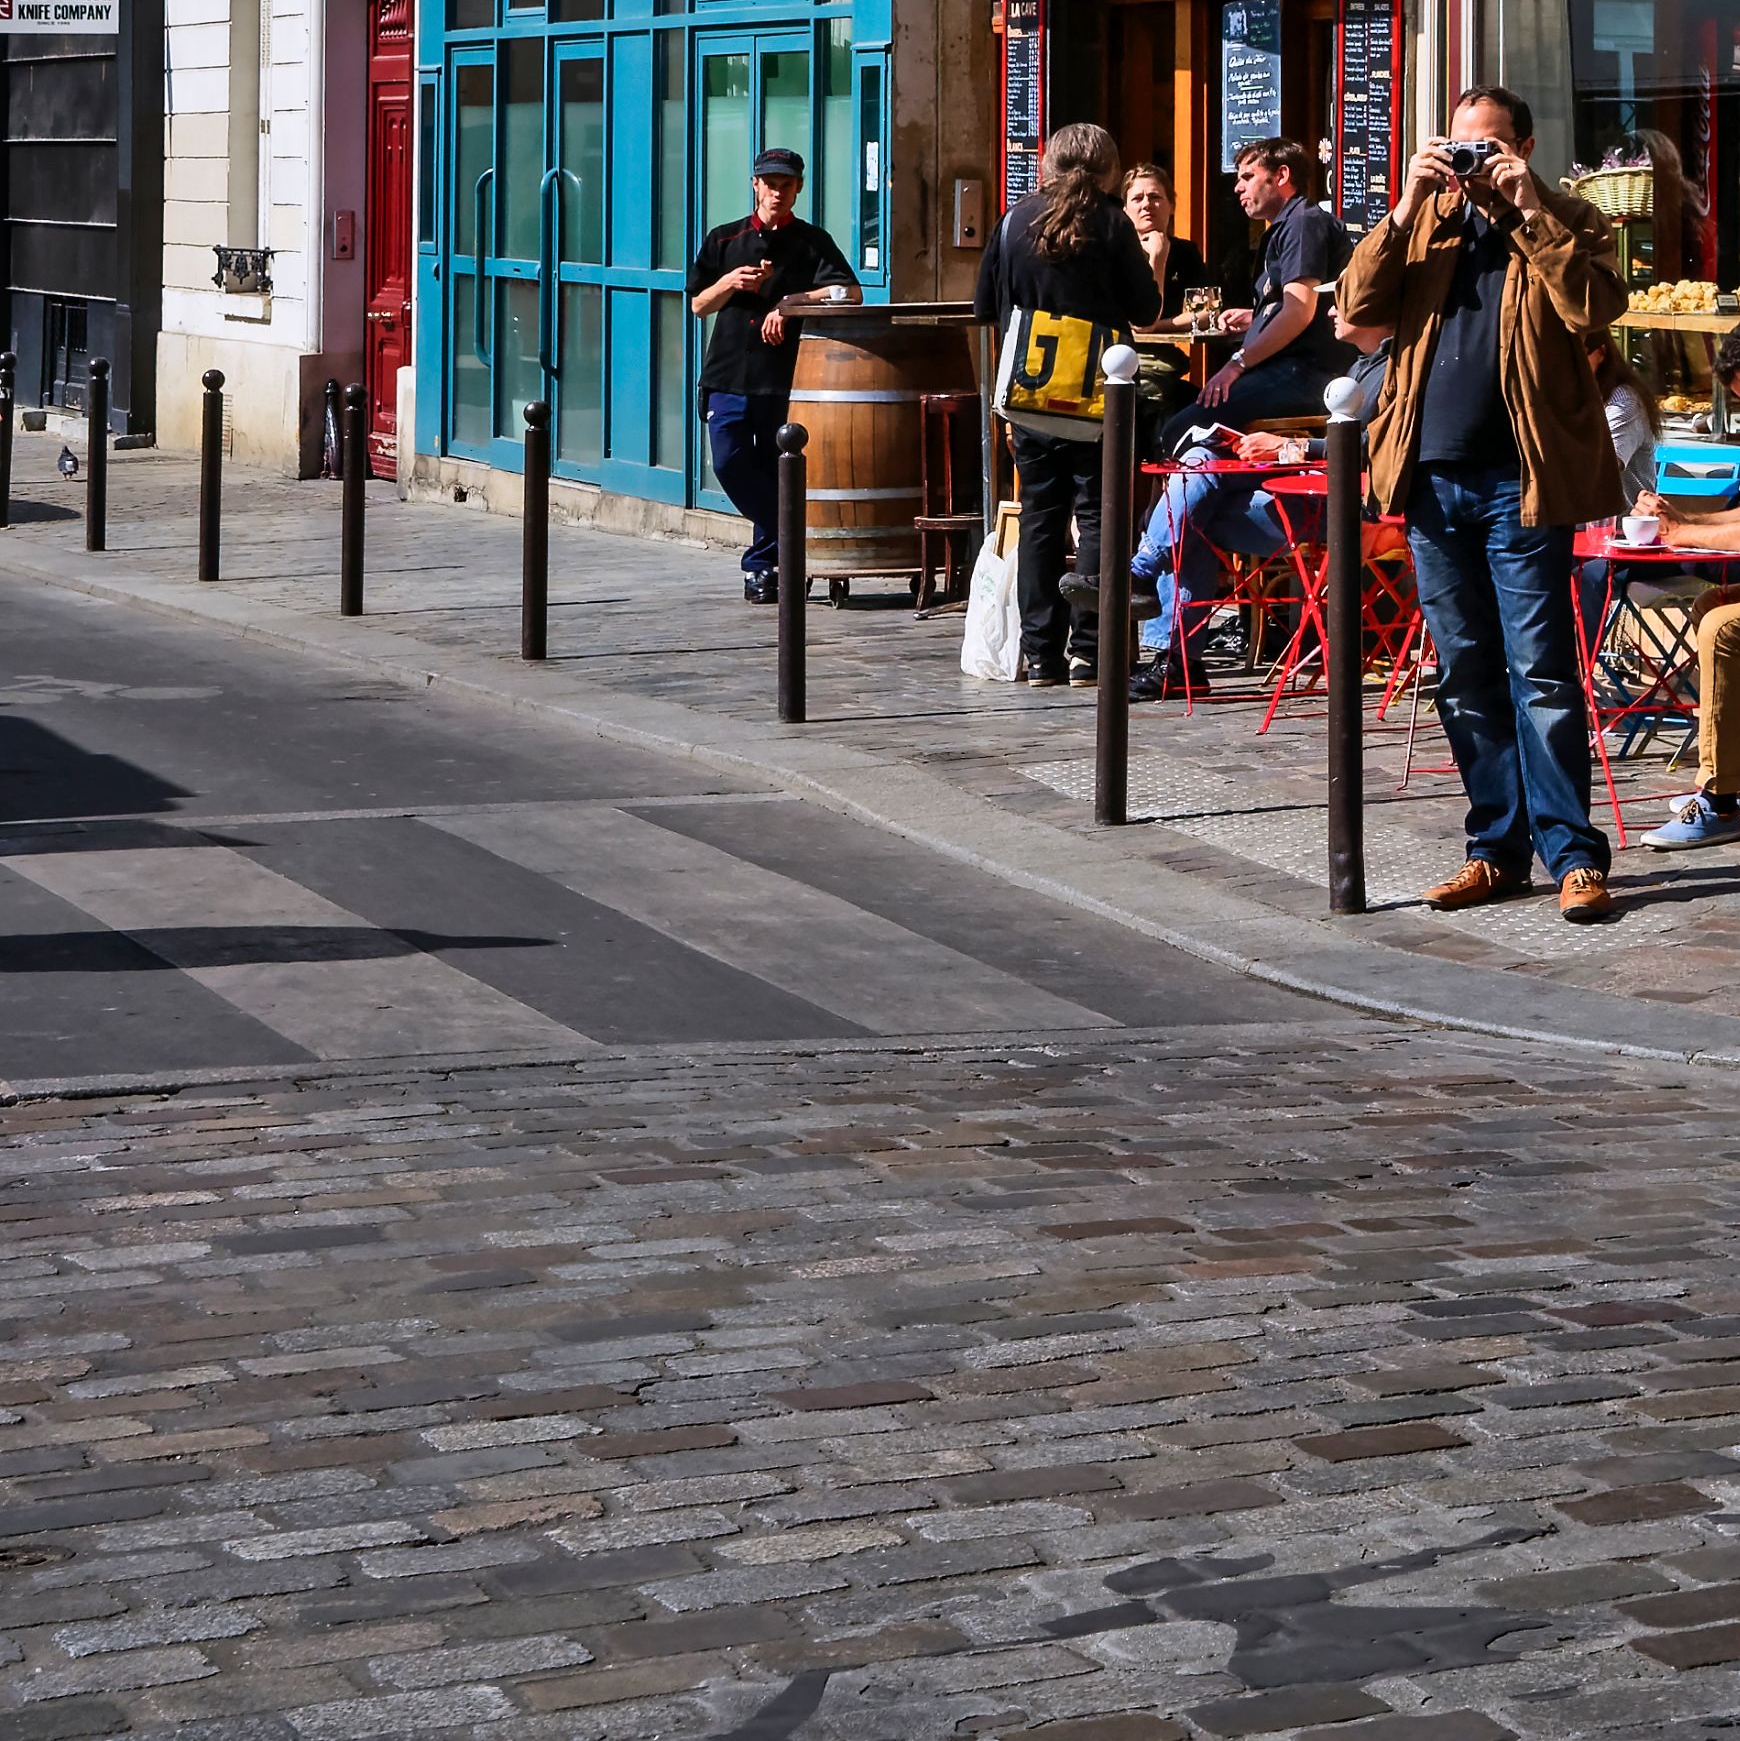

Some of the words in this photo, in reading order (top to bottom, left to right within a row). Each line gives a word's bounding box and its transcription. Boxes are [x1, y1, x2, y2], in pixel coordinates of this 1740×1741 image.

[18, 4, 51, 20] KNIFE
[54, 4, 112, 20] COMPANY
[1011, 2, 1020, 18] LA
[1021, 1, 1037, 16] CAVE
